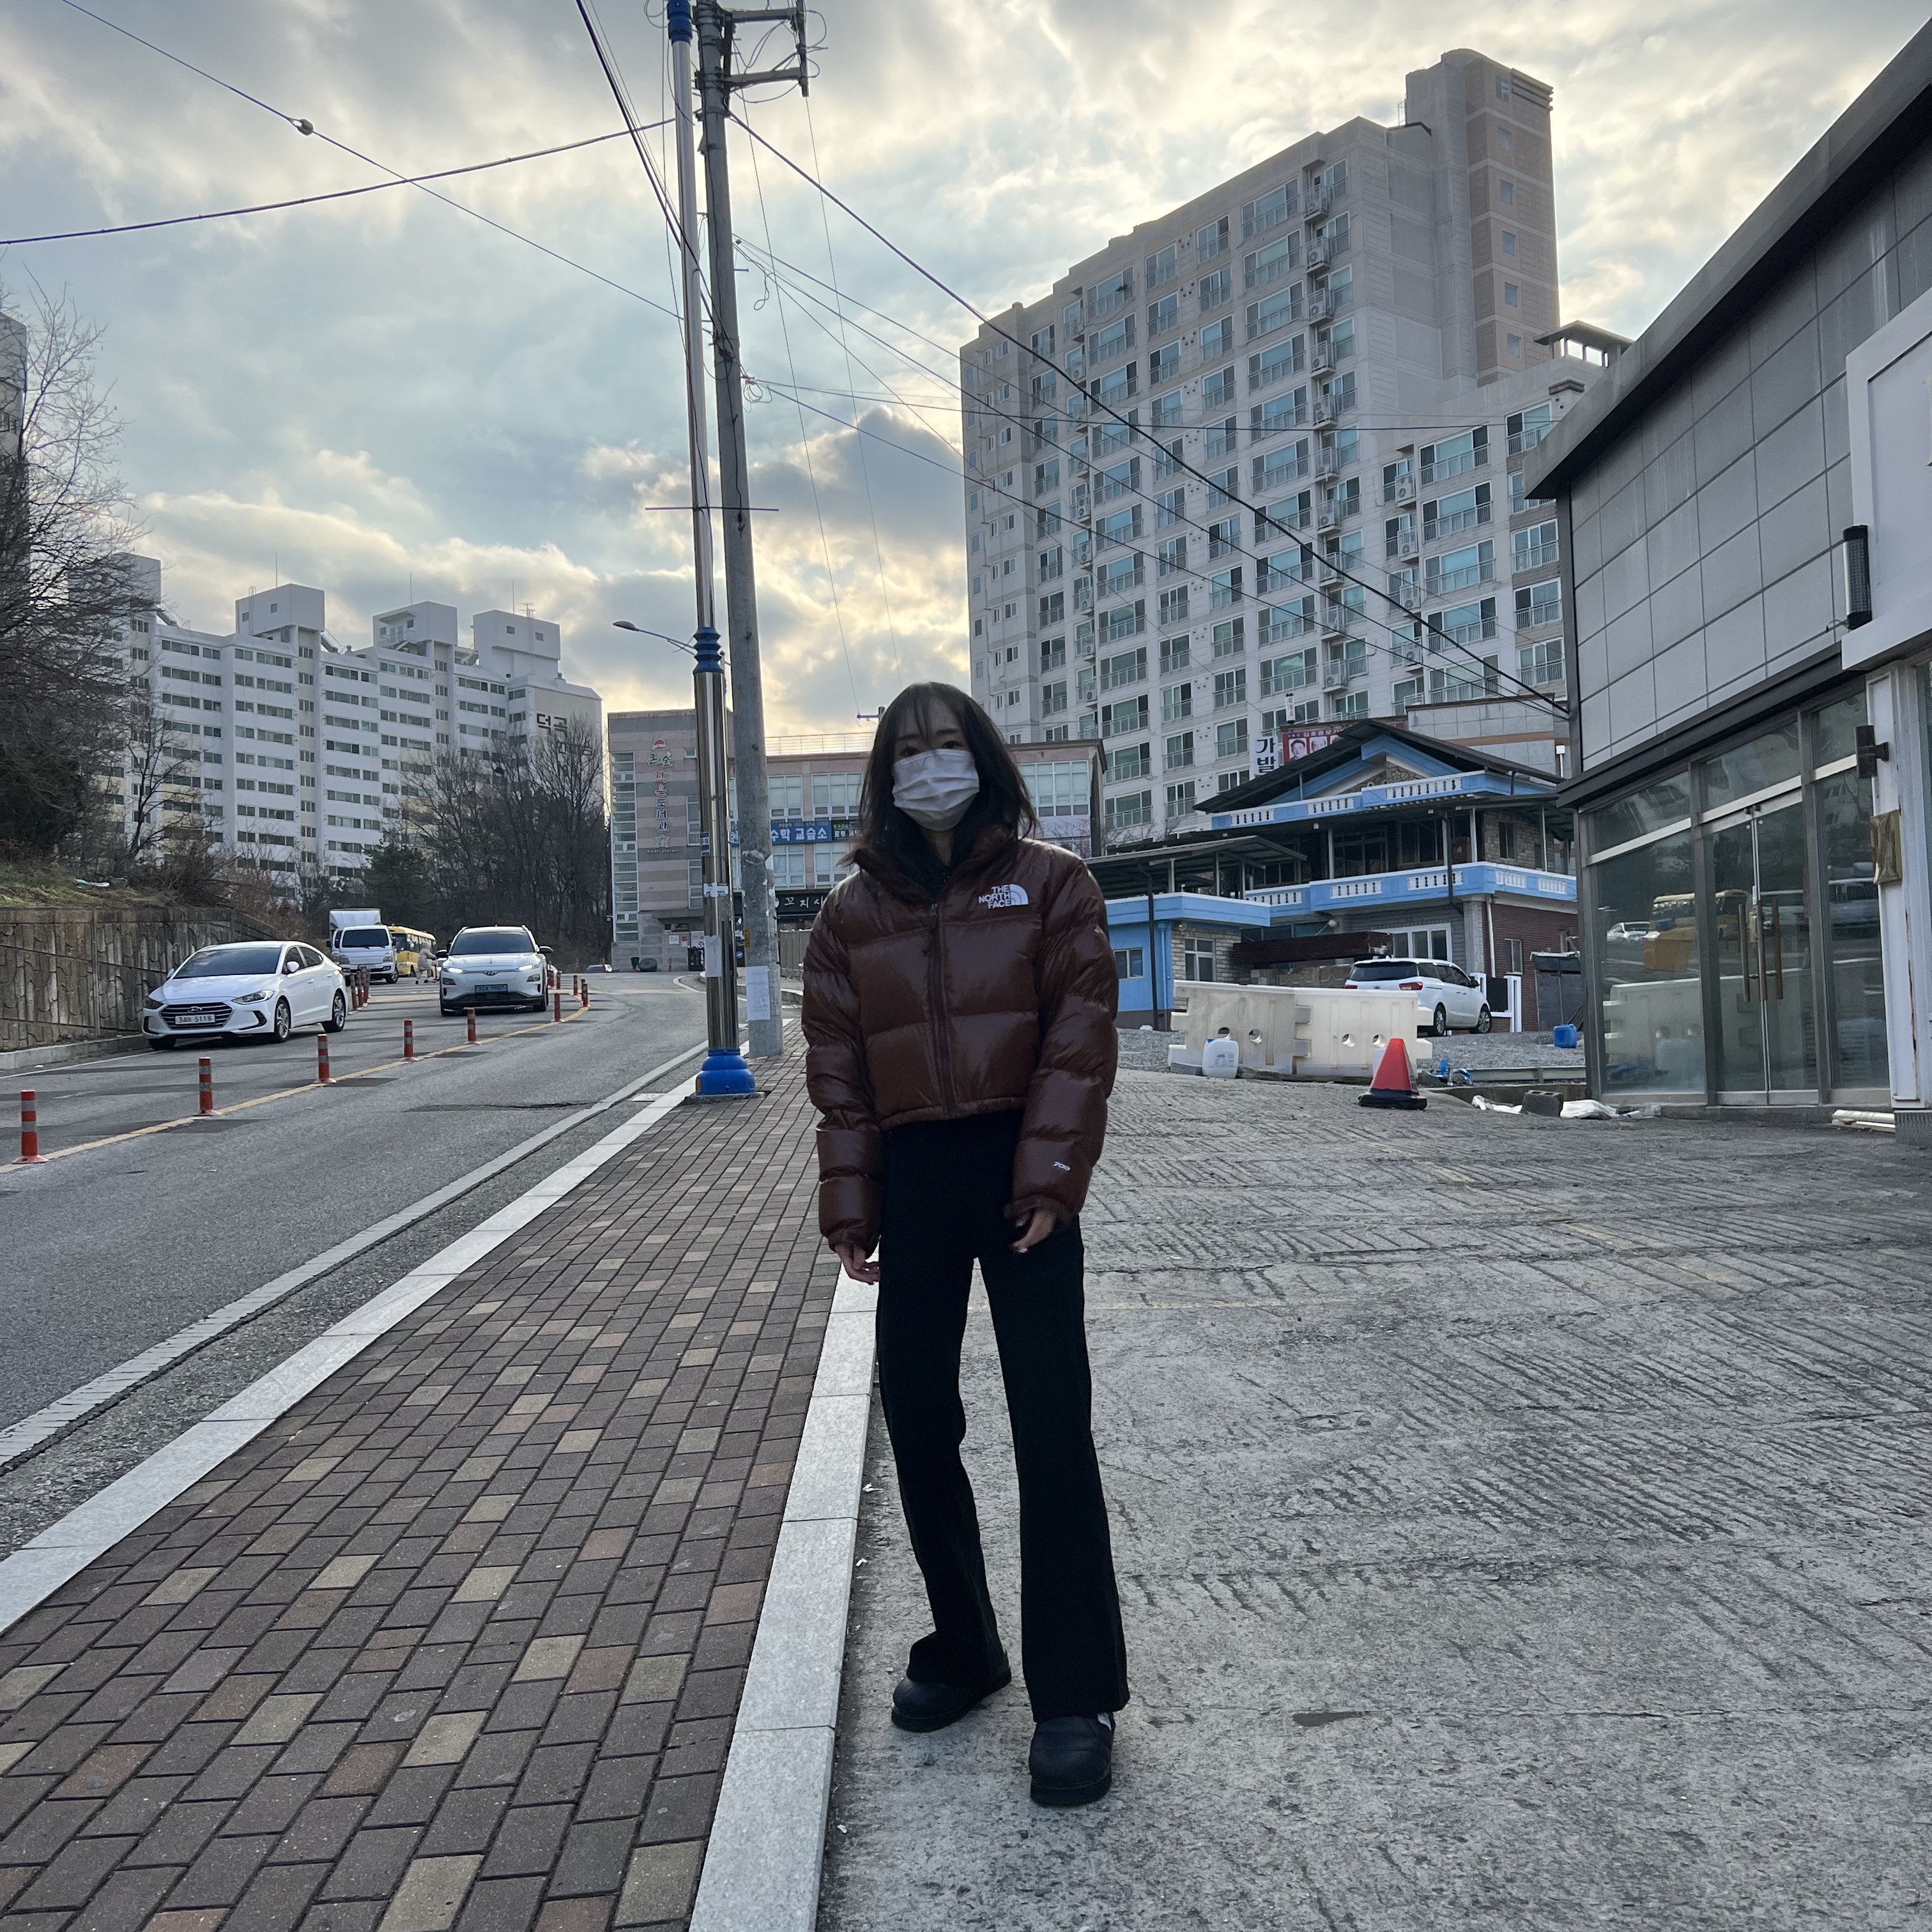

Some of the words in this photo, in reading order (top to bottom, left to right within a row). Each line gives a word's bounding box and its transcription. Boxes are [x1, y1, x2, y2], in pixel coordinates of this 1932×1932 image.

[537, 713, 568, 738] 덕곡
[1255, 737, 1276, 774] 가발
[771, 828, 790, 843] 수학
[795, 827, 827, 841] 교습소
[991, 885, 1009, 894] THE
[979, 892, 1010, 903] NORTH
[988, 899, 1011, 908] FACE
